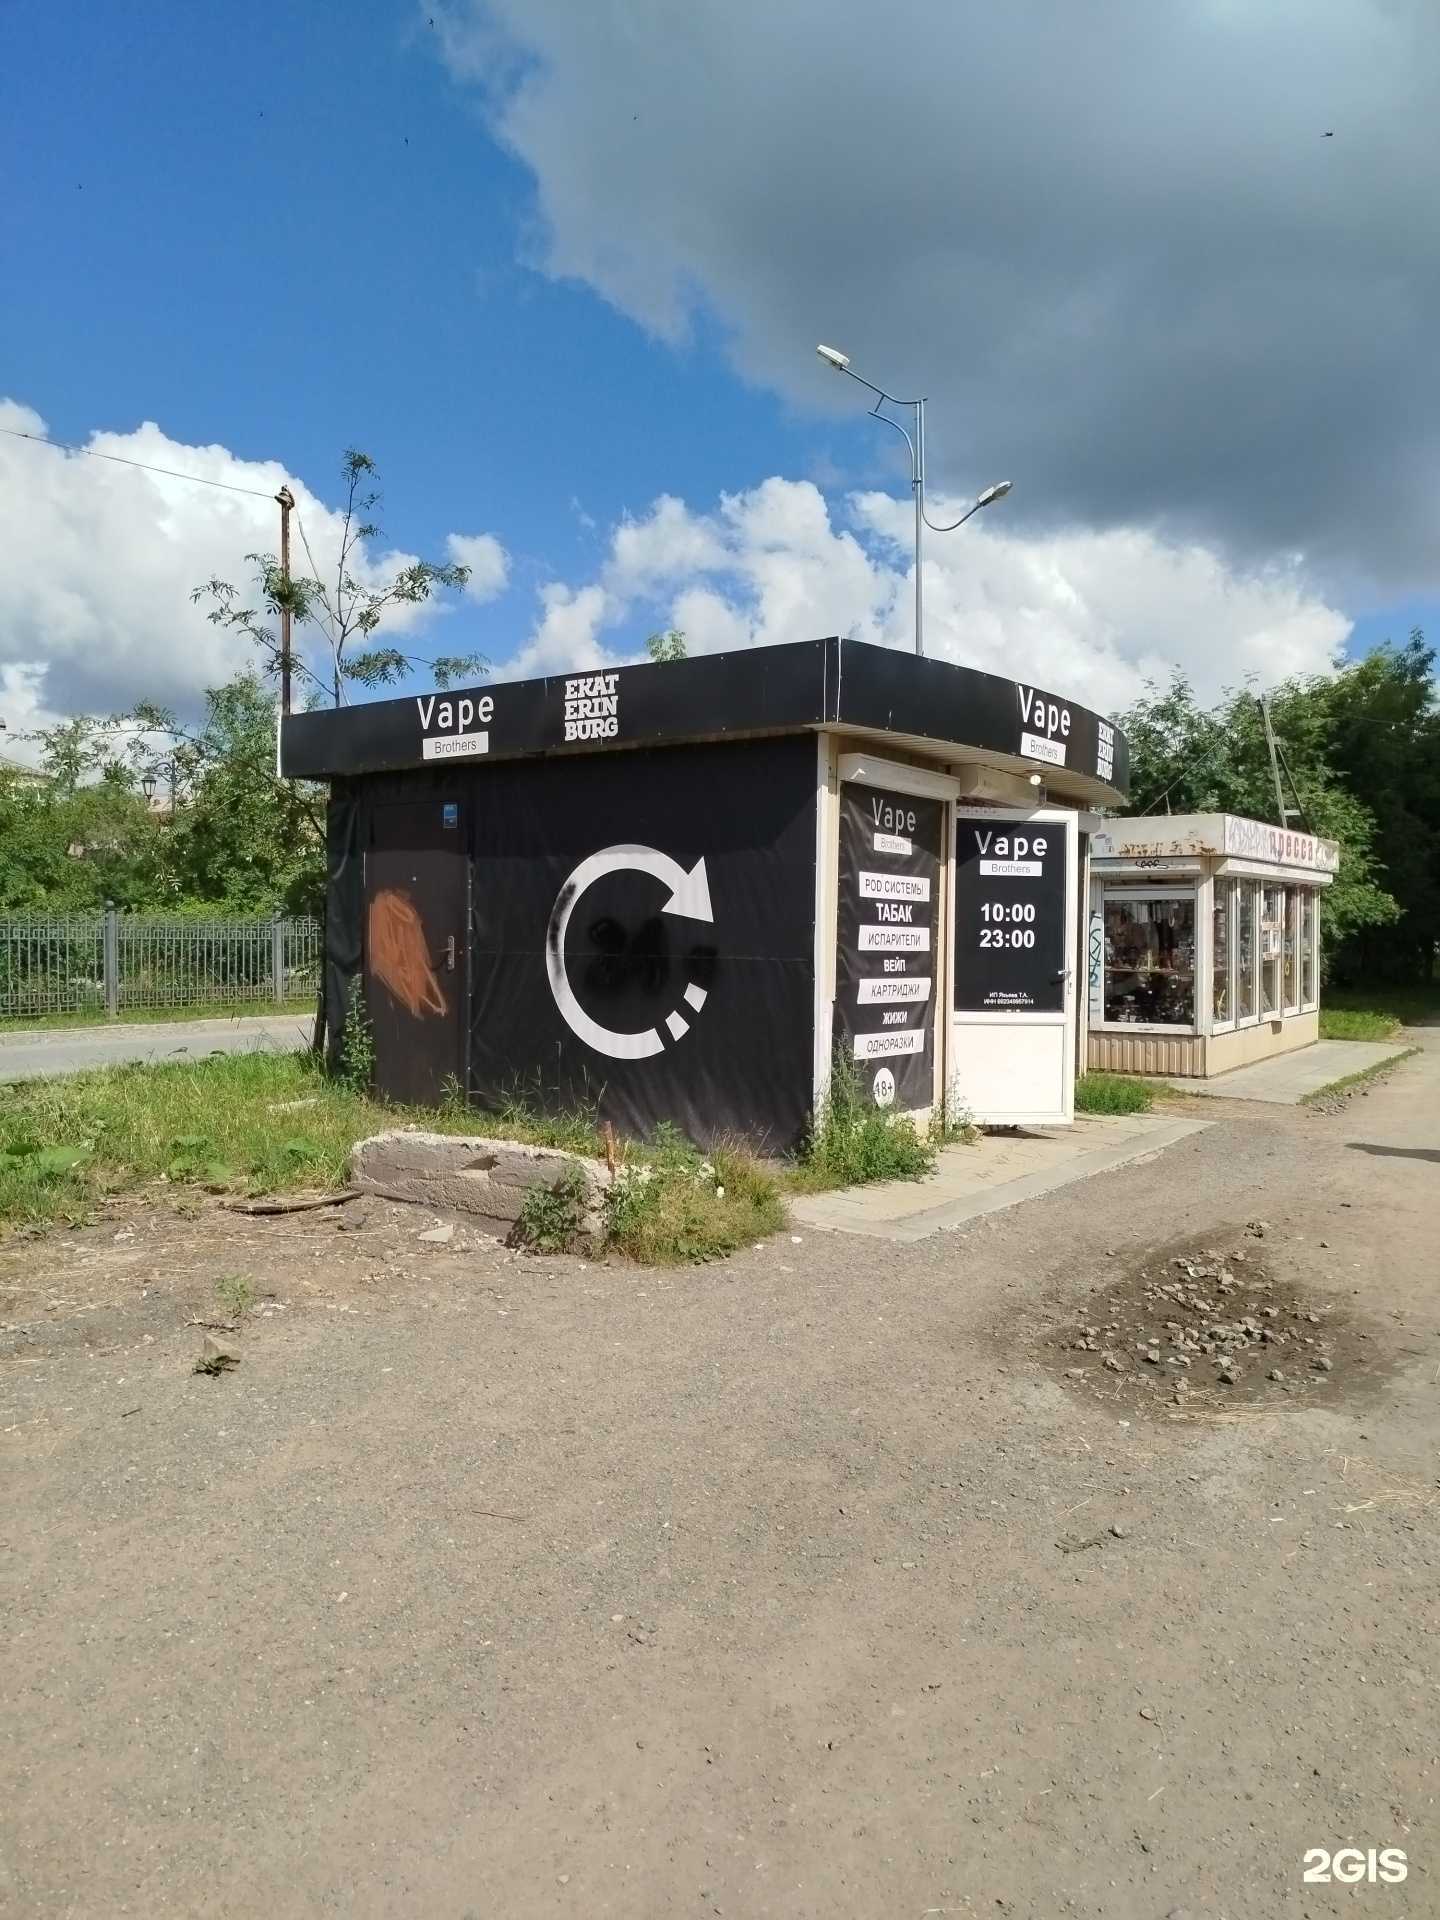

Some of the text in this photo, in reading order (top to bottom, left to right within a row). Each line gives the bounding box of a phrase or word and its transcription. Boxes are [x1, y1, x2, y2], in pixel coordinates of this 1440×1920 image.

[565, 674, 619, 700] EKAT
[417, 695, 494, 734] Vape
[565, 695, 618, 720] ERIN
[1018, 685, 1071, 739] Vape
[565, 717, 619, 741] BURG
[435, 739, 477, 754] Brothers
[1030, 739, 1058, 760] Brothers
[872, 797, 916, 835] Vape
[974, 830, 1048, 861] Vape
[991, 863, 1031, 874] Brothers
[865, 878, 923, 895] POD СИСТЕМЫ
[876, 903, 912, 923] ТАБАК
[980, 903, 1035, 922] 10:00
[868, 933, 920, 946] ИСПАРИТЕЛИ
[979, 929, 1035, 948] 23:00
[884, 957, 906, 972] ВЕЙП
[872, 983, 920, 997] КАРТРИДЖИ
[882, 1011, 908, 1025] ЖИЖИ
[867, 1036, 914, 1053] ОДНОРАЗКИ
[874, 1080, 893, 1097] 18+
